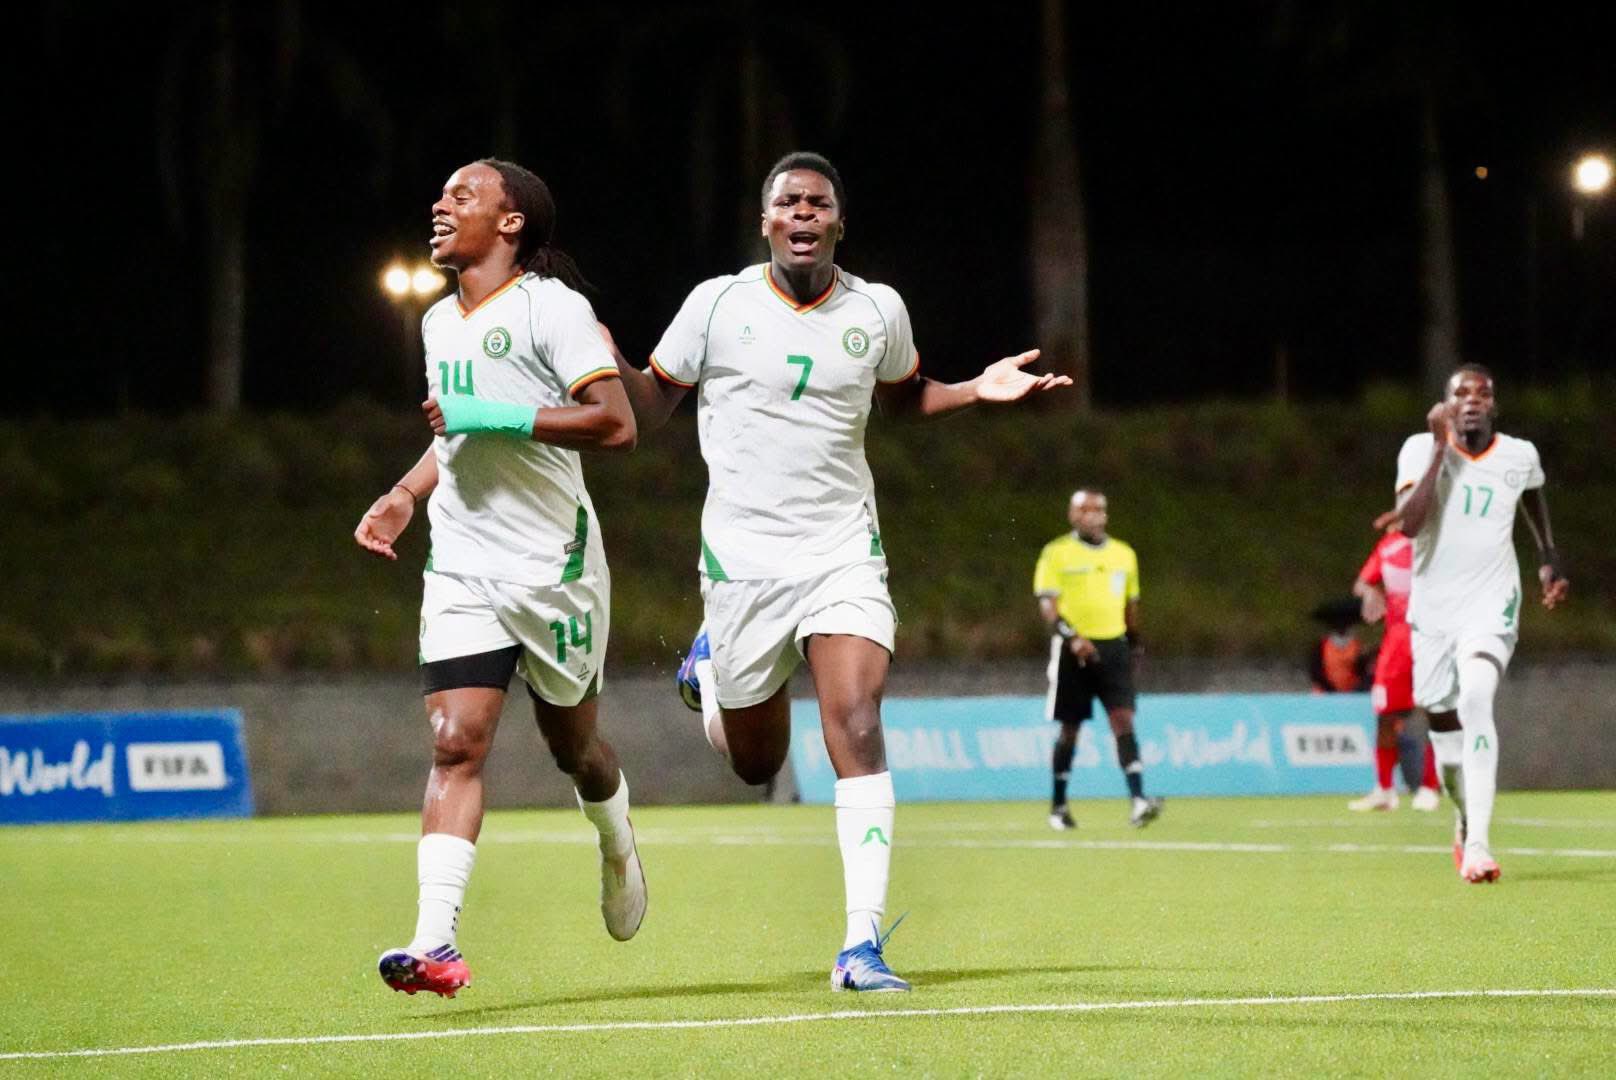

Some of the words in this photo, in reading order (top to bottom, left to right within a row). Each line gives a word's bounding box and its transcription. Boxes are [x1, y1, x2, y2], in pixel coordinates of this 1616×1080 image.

[438, 360, 475, 396] 14
[786, 354, 814, 401] 7
[1463, 483, 1494, 518] 17
[549, 610, 592, 664] 14
[803, 727, 974, 769] FBALL
[1296, 735, 1358, 752] FIFA
[0, 738, 115, 797] World
[144, 756, 209, 775] FIFA
